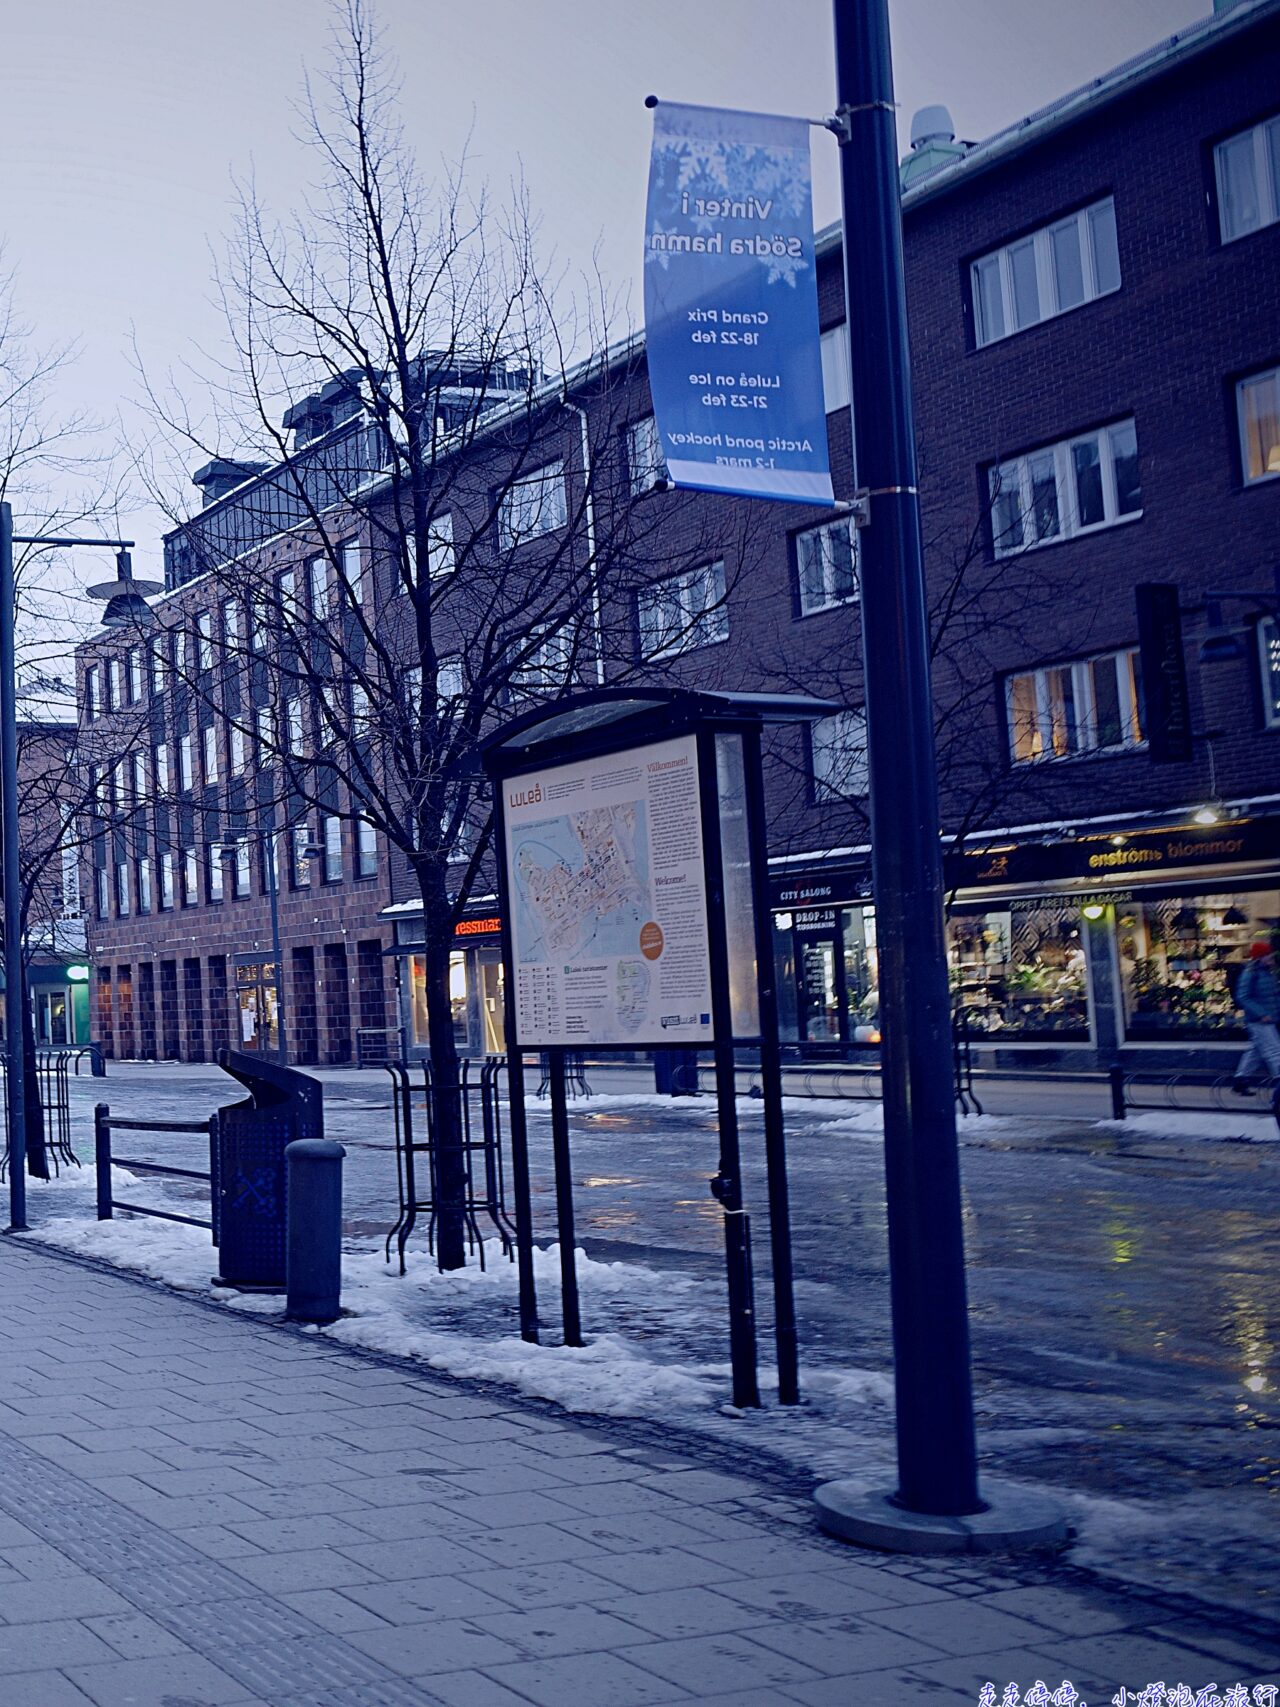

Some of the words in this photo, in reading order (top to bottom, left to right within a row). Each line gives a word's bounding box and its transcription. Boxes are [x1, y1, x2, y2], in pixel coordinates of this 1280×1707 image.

[646, 756, 688, 773] Välkommen!
[1167, 838, 1245, 858] blommor
[654, 873, 687, 887] Welcome!
[780, 891, 799, 901] CITY
[799, 886, 832, 899] SALONG
[795, 910, 836, 923] DROP-IN
